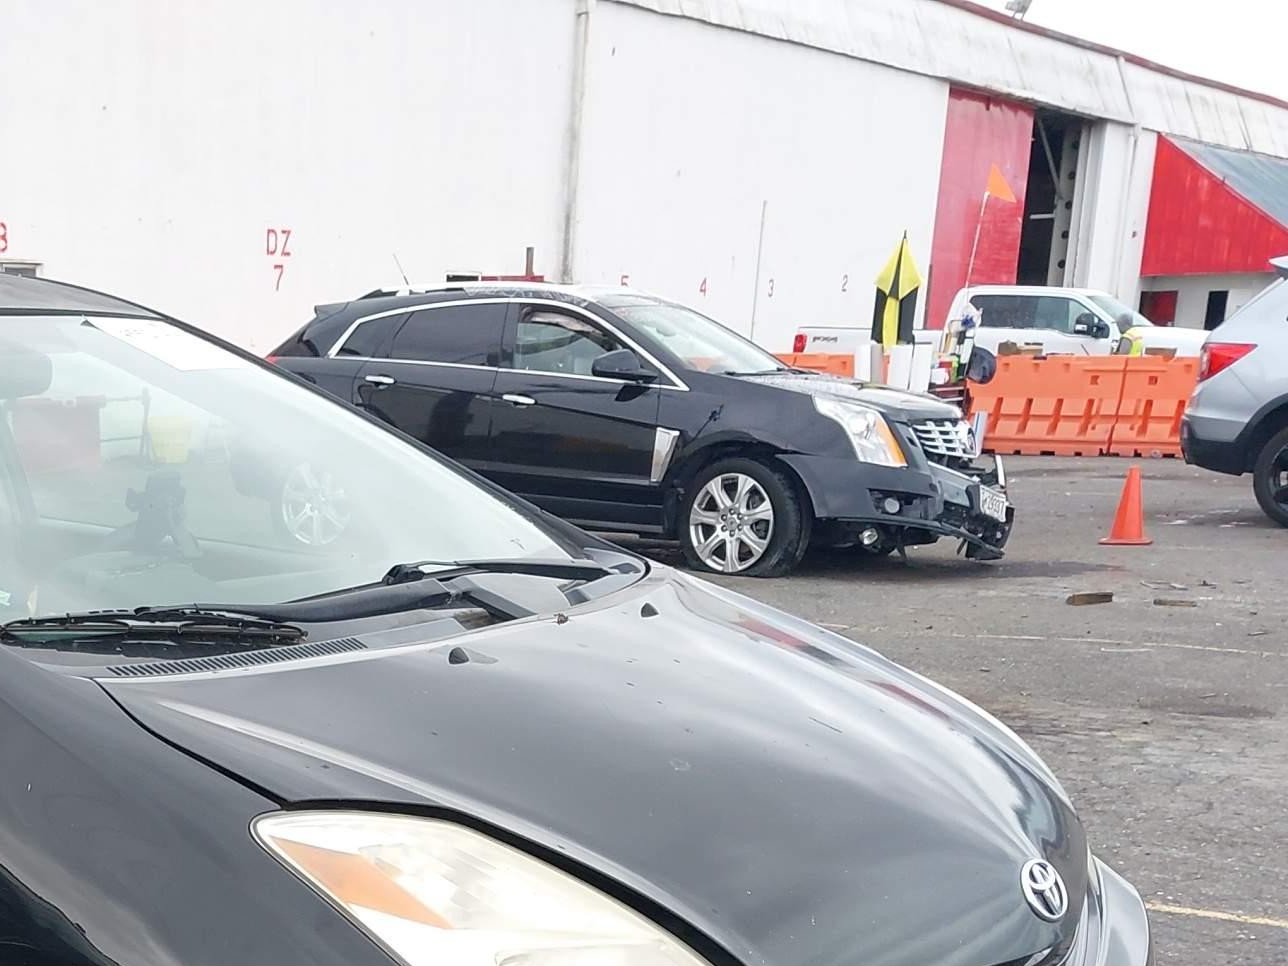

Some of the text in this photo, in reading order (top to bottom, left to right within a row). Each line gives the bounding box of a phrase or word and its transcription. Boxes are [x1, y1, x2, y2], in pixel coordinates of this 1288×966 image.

[266, 229, 292, 257] DZ
[273, 264, 284, 291] 7
[699, 277, 707, 296] 4
[841, 274, 848, 292] 2
[767, 279, 774, 298] 3
